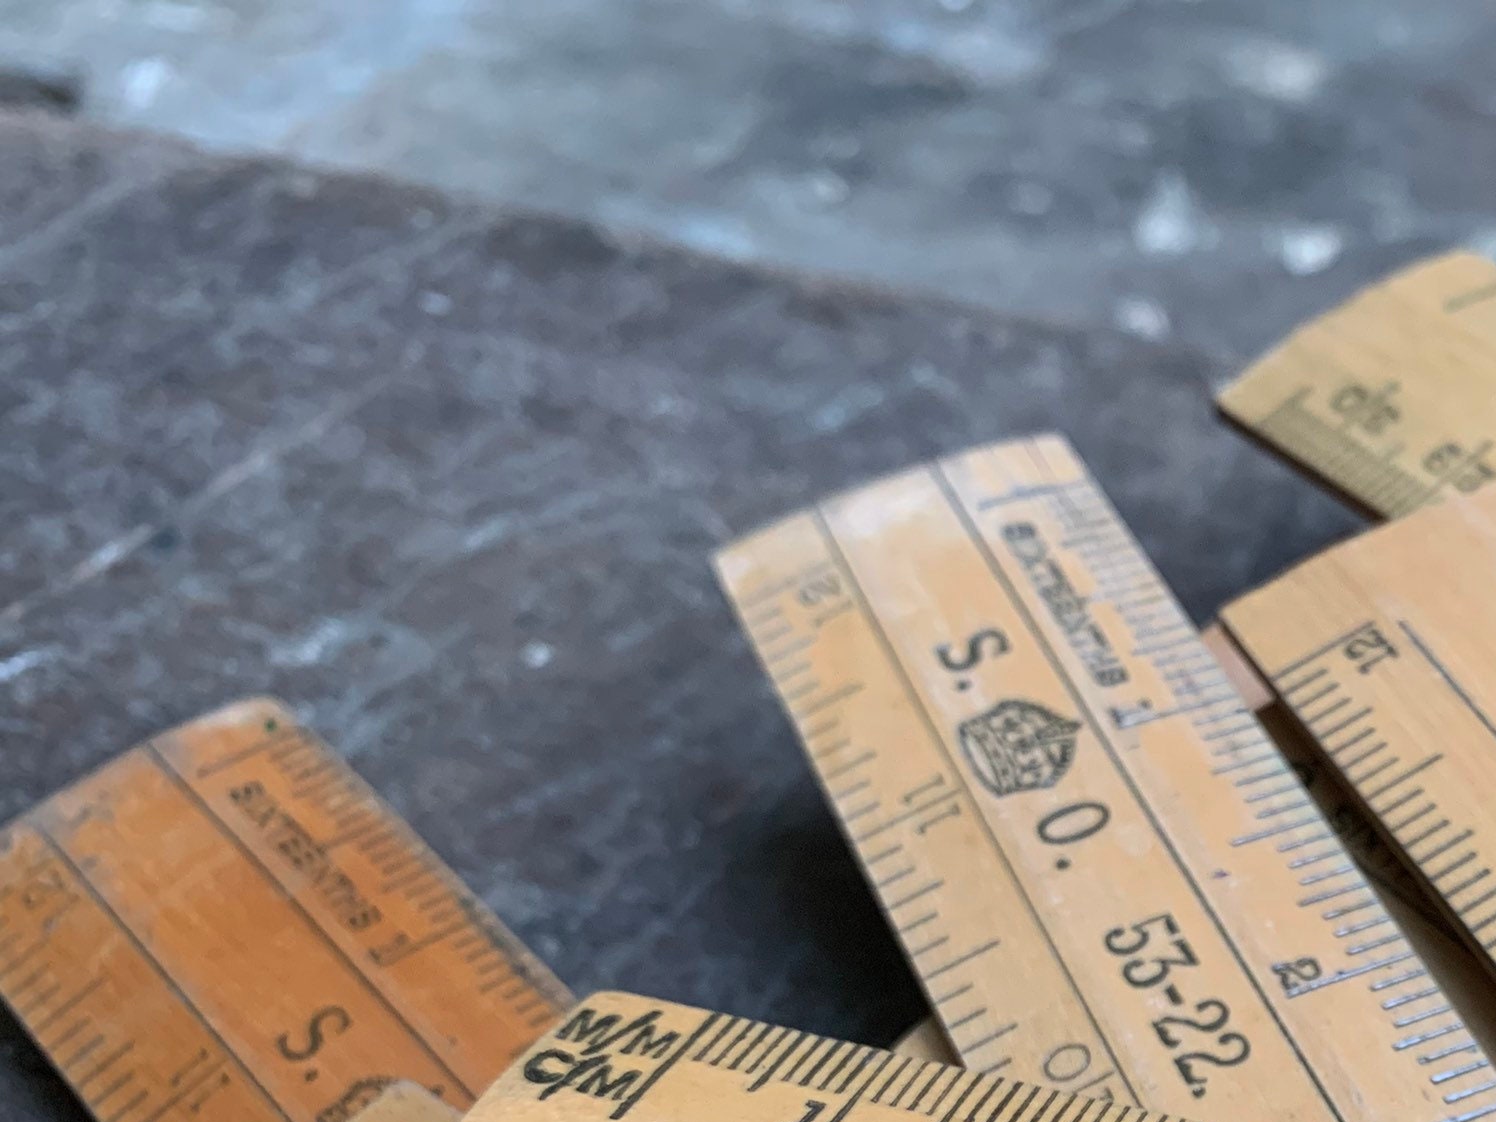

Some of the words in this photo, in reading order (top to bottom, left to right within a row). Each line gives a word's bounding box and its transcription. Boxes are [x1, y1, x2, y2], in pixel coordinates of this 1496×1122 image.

[1342, 621, 1400, 677] 12
[936, 627, 1011, 692] S.
[1036, 801, 1110, 871] O.
[1104, 913, 1252, 1099] 53-22.
[278, 1004, 350, 1082] S.
[555, 1005, 680, 1059] M/M
[523, 1049, 645, 1102] C/M
